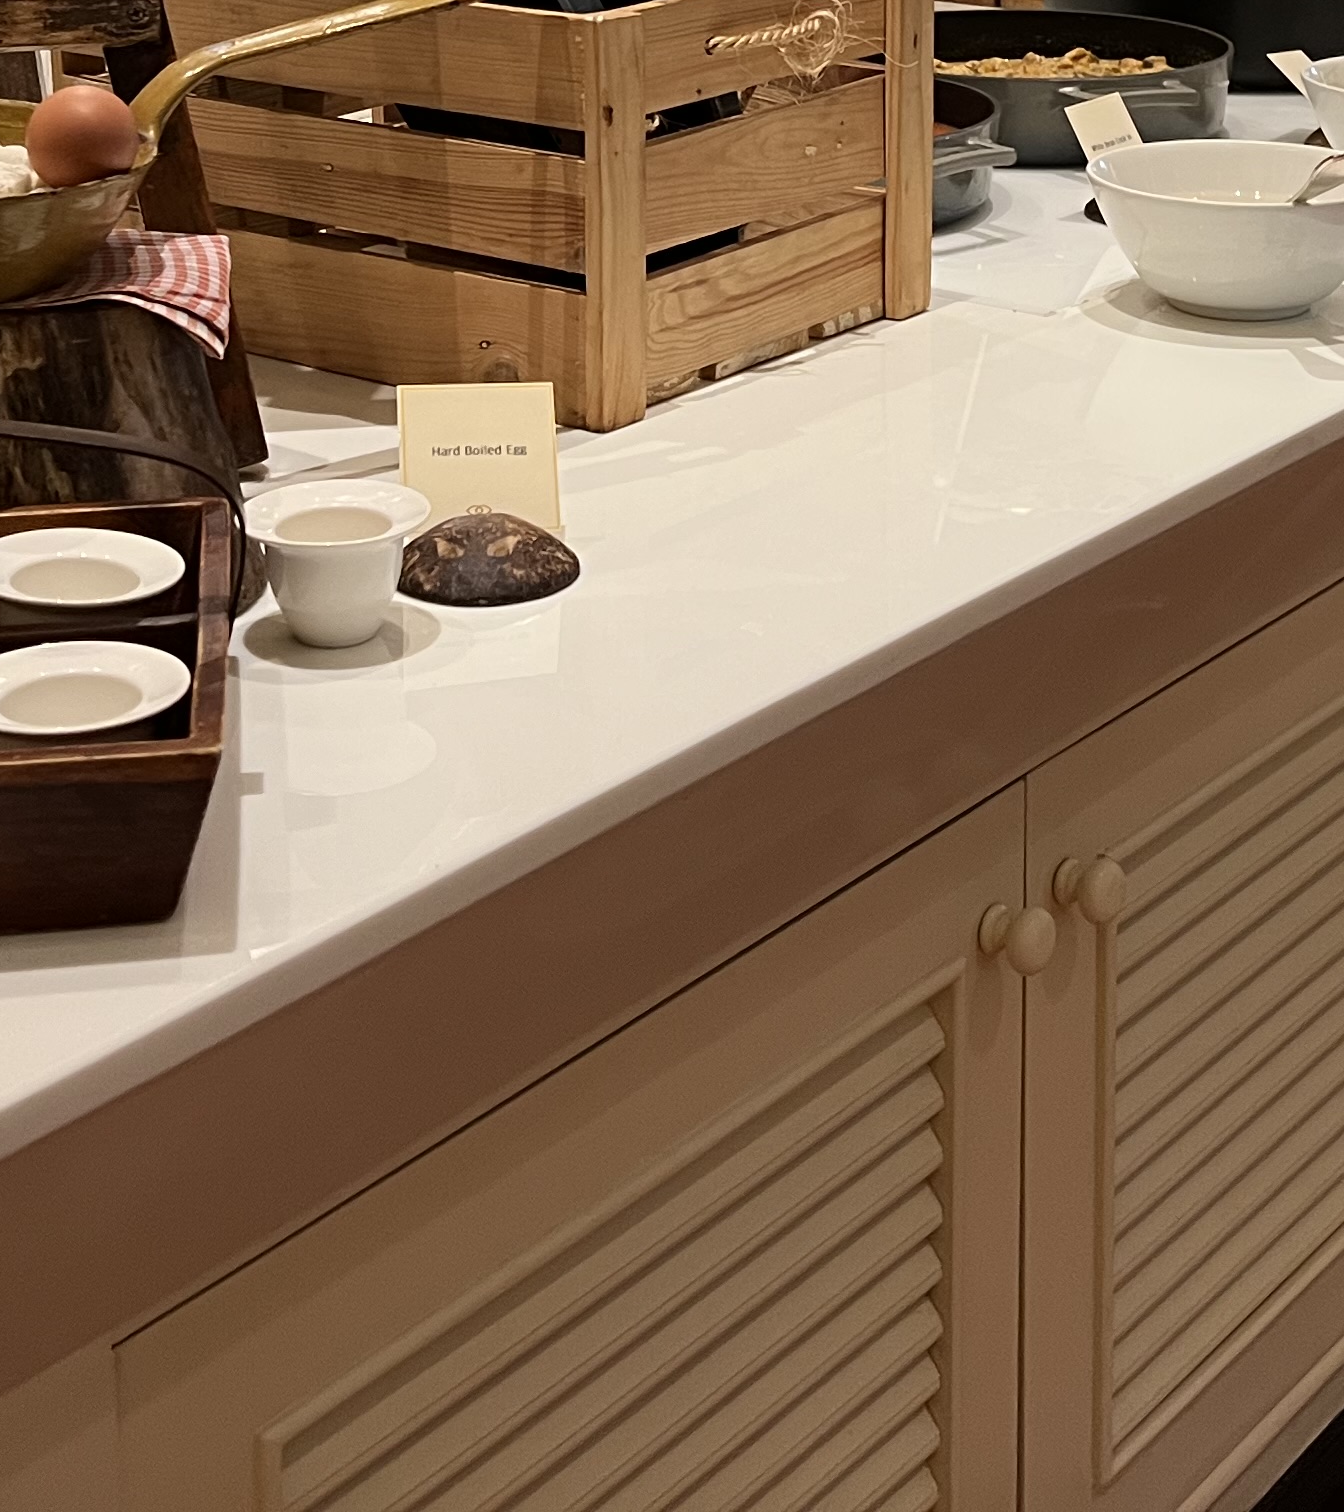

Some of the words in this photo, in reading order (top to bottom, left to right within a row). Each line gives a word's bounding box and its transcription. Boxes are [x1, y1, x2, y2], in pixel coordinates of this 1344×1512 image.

[431, 444, 461, 456] Hard
[464, 444, 503, 456] Boiled
[506, 443, 528, 456] Egg
